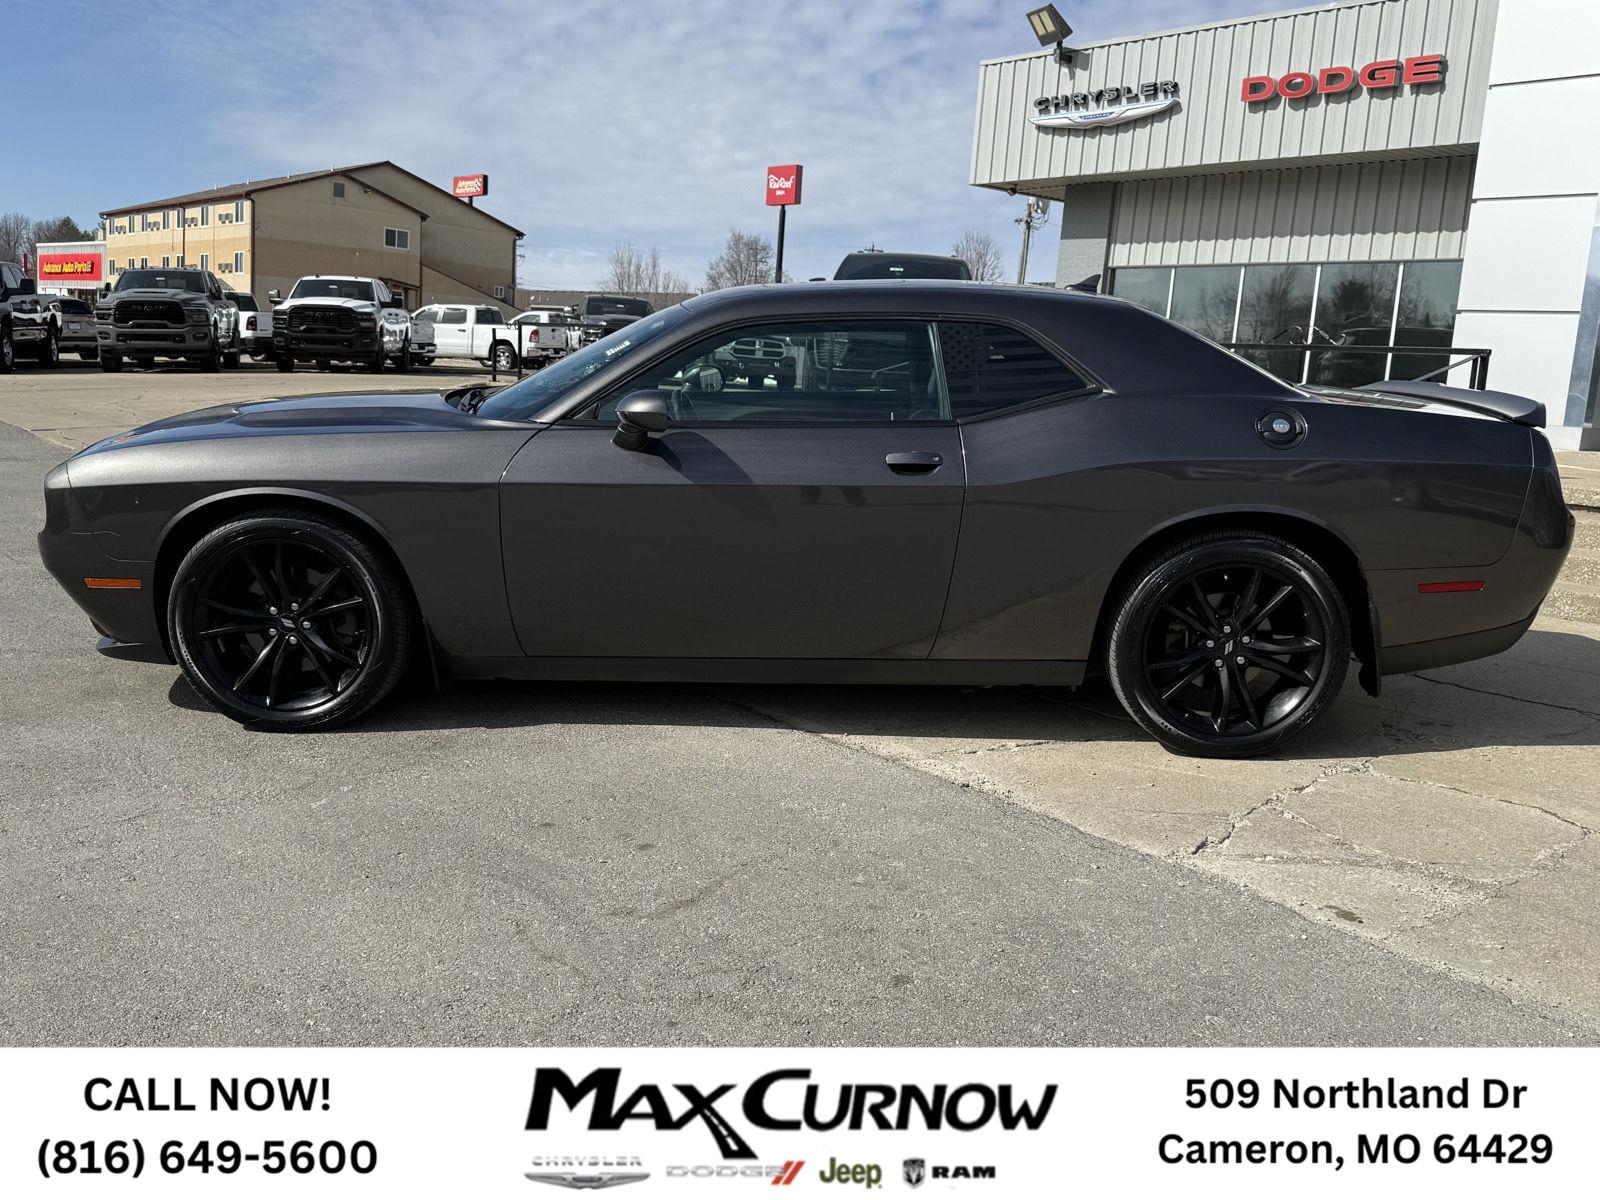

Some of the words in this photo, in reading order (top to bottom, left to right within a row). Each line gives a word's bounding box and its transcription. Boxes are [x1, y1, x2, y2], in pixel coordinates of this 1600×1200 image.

[1241, 54, 1444, 102] DODGE
[1034, 80, 1178, 110] CHRYSLER
[43, 262, 62, 273] Advance
[62, 262, 74, 273] Auto
[74, 261, 88, 273] Parts
